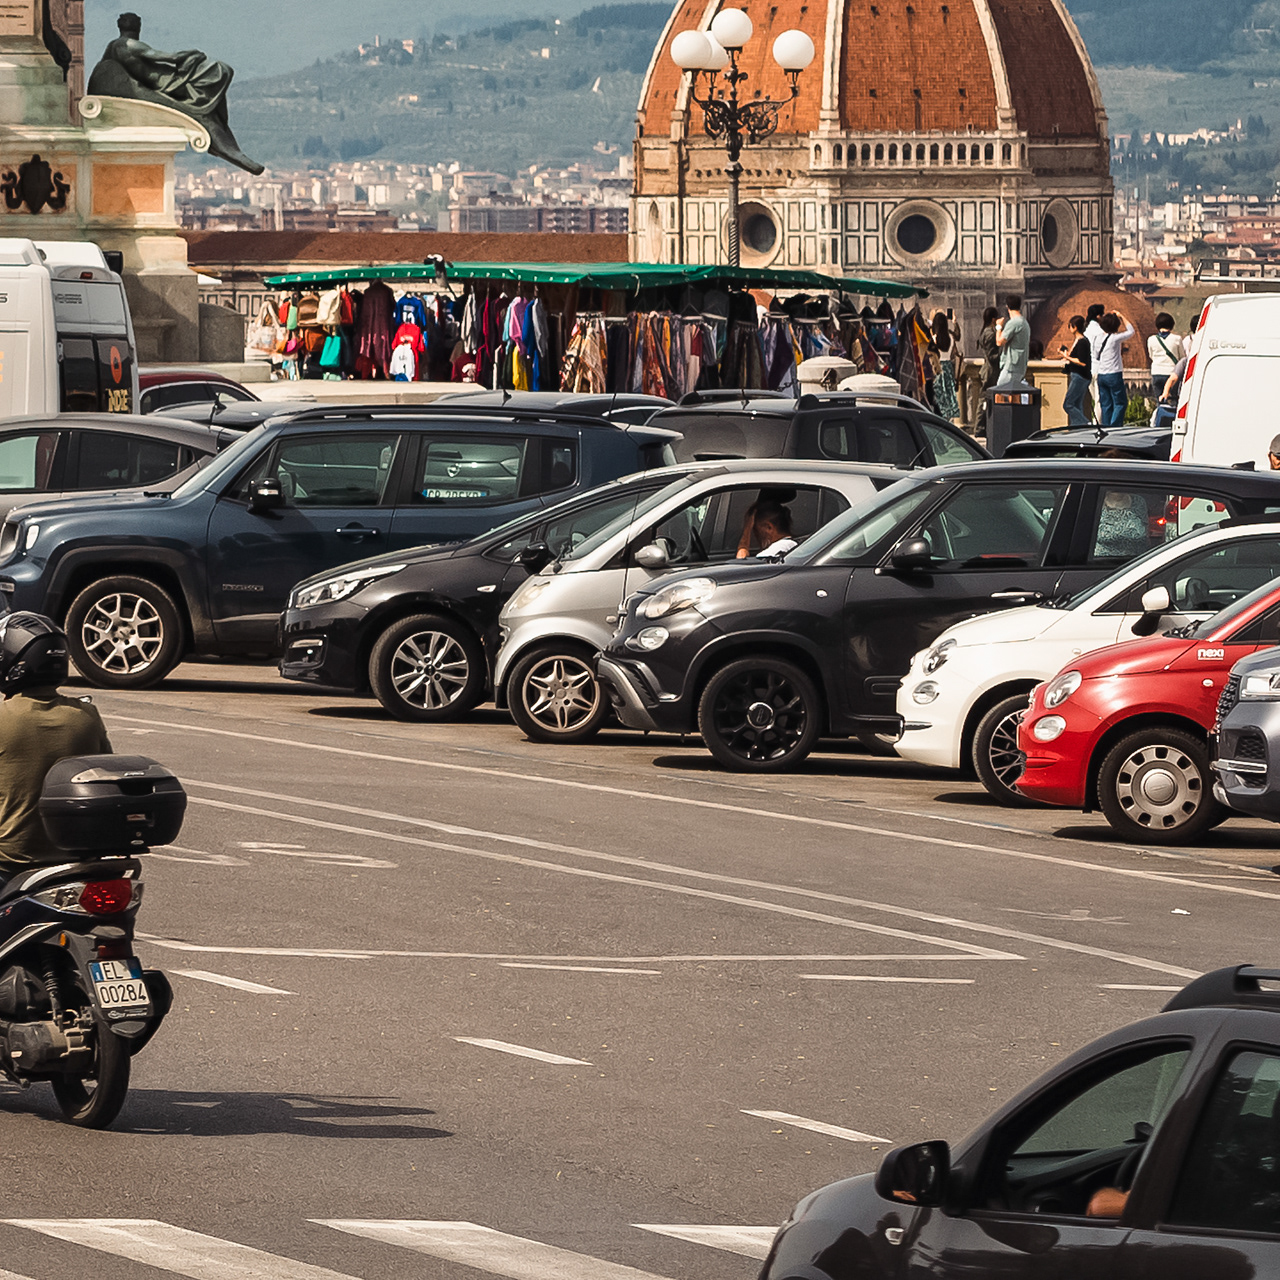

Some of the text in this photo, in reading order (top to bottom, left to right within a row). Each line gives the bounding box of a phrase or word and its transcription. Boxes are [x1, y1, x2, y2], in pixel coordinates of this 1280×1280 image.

[1198, 649, 1224, 658] nexi
[102, 962, 123, 979] EL
[100, 983, 146, 1003] 00284
